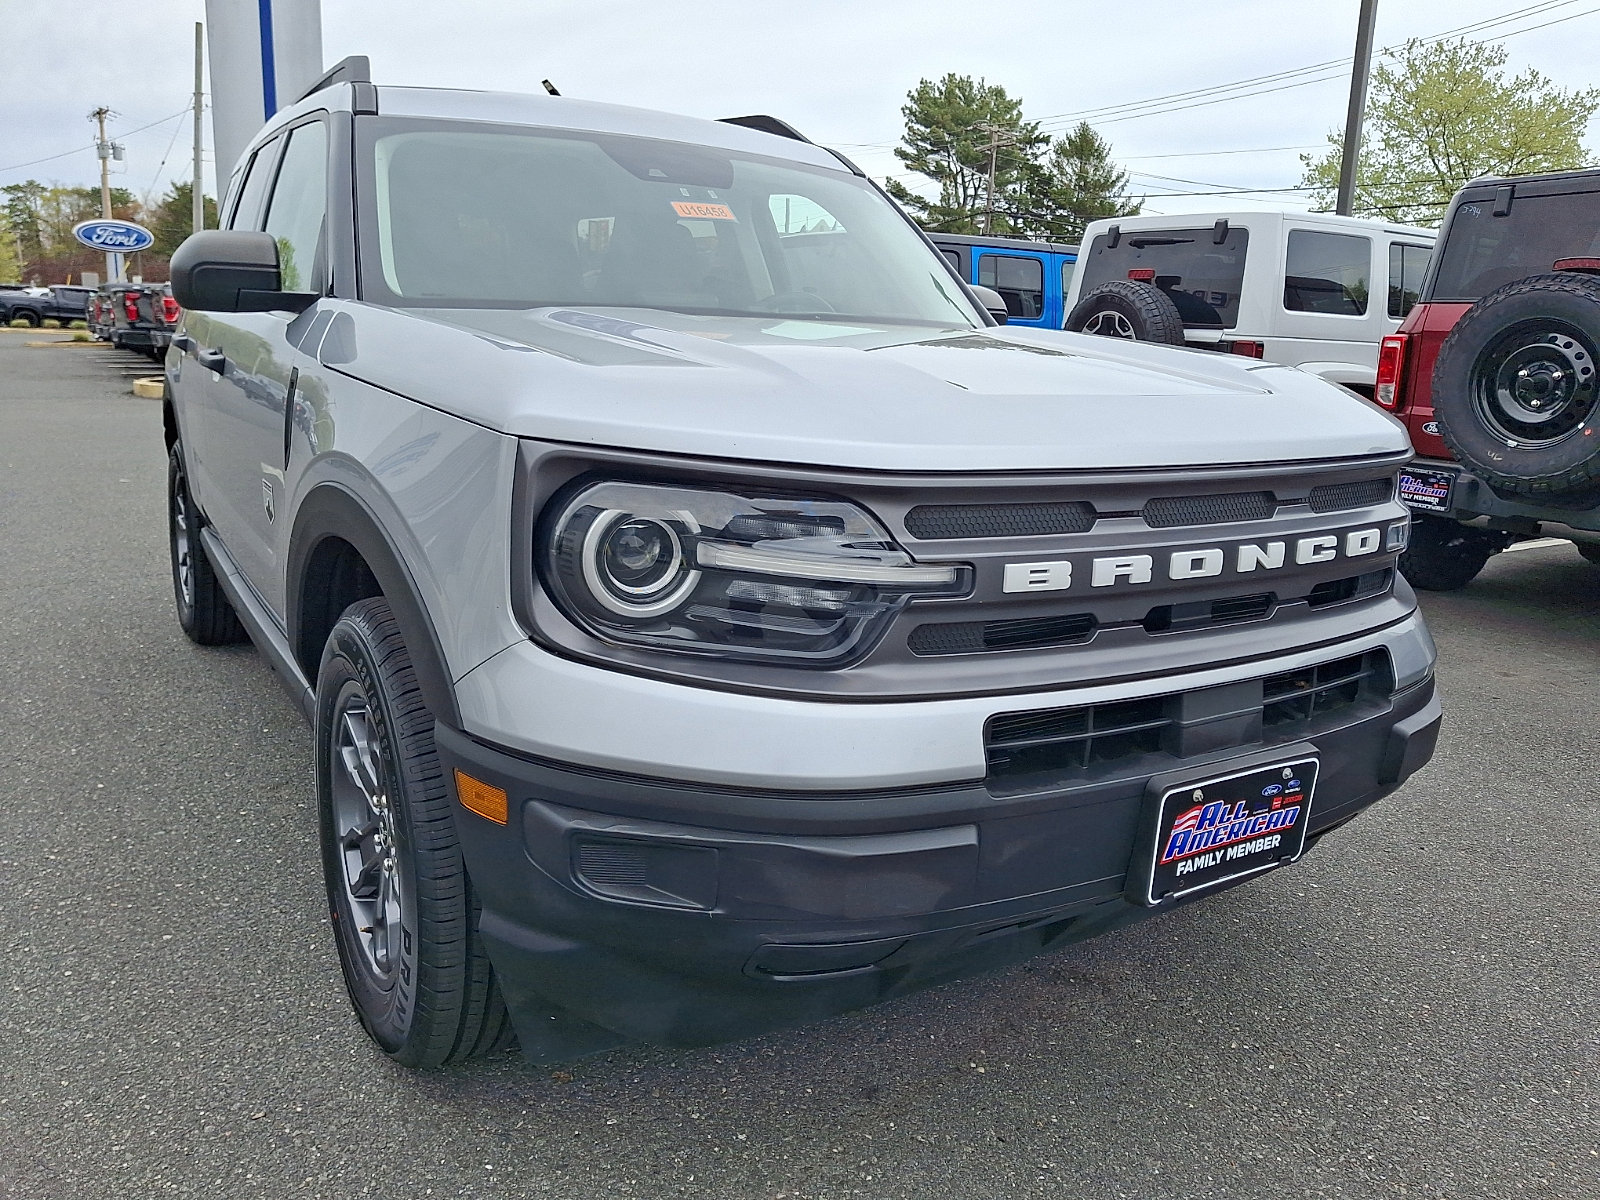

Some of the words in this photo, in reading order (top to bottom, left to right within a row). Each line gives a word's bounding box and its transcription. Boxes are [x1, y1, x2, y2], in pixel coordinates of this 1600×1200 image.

[679, 204, 728, 218] U16458
[92, 226, 138, 246] Ford
[1002, 528, 1382, 594] BRONCO
[1163, 806, 1300, 861] AMERICAN
[1195, 800, 1249, 831] ALL
[1176, 849, 1225, 876] FAMILY
[1226, 835, 1281, 861] MEMBER
